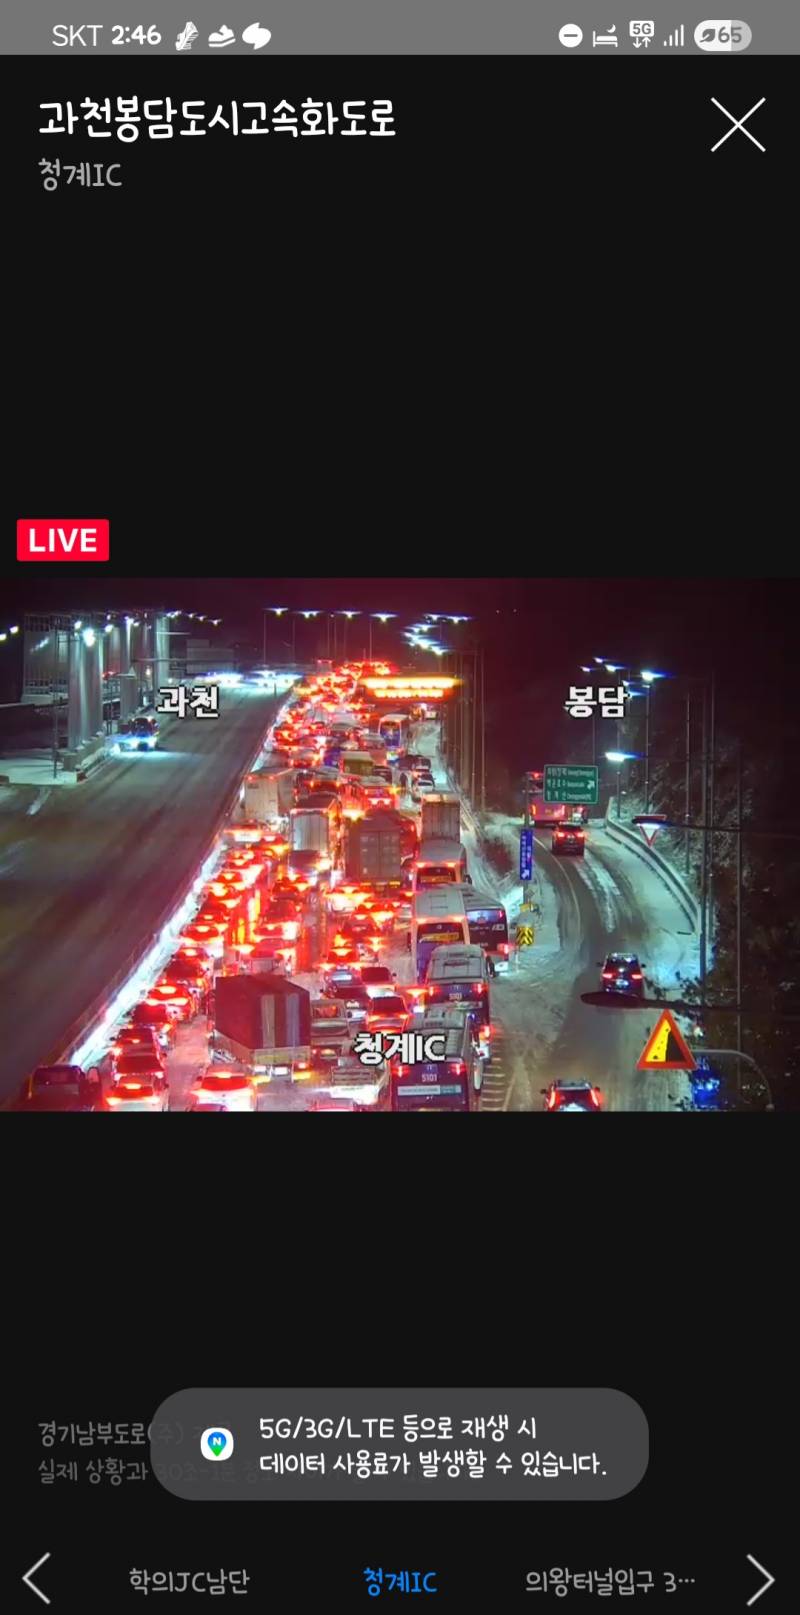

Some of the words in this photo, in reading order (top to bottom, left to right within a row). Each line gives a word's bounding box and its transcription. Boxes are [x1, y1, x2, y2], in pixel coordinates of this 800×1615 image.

[52, 24, 103, 47] SKT
[111, 24, 162, 46] 2:46
[632, 23, 652, 35] 5G
[718, 27, 743, 43] 65
[38, 95, 397, 143] 과천봉담도시고속화도로
[37, 158, 123, 191] 청계IC
[29, 527, 97, 553] LIVE
[259, 1415, 395, 1439] 5G/3G/LTE
[402, 1414, 454, 1443] 등으로
[460, 1414, 509, 1443] 재생
[517, 1416, 537, 1439] 시
[38, 1458, 78, 1485] 실제
[85, 1456, 149, 1486] 상황과
[259, 1452, 326, 1475] 데이터
[332, 1450, 412, 1479] 사용료가
[418, 1448, 488, 1479] 발생할
[495, 1451, 513, 1475] 수
[520, 1450, 607, 1478] 있습니다.
[128, 1567, 251, 1596] 학의JC남단
[362, 1566, 439, 1598] 청계IC
[525, 1566, 655, 1598] 의왕터널입구
